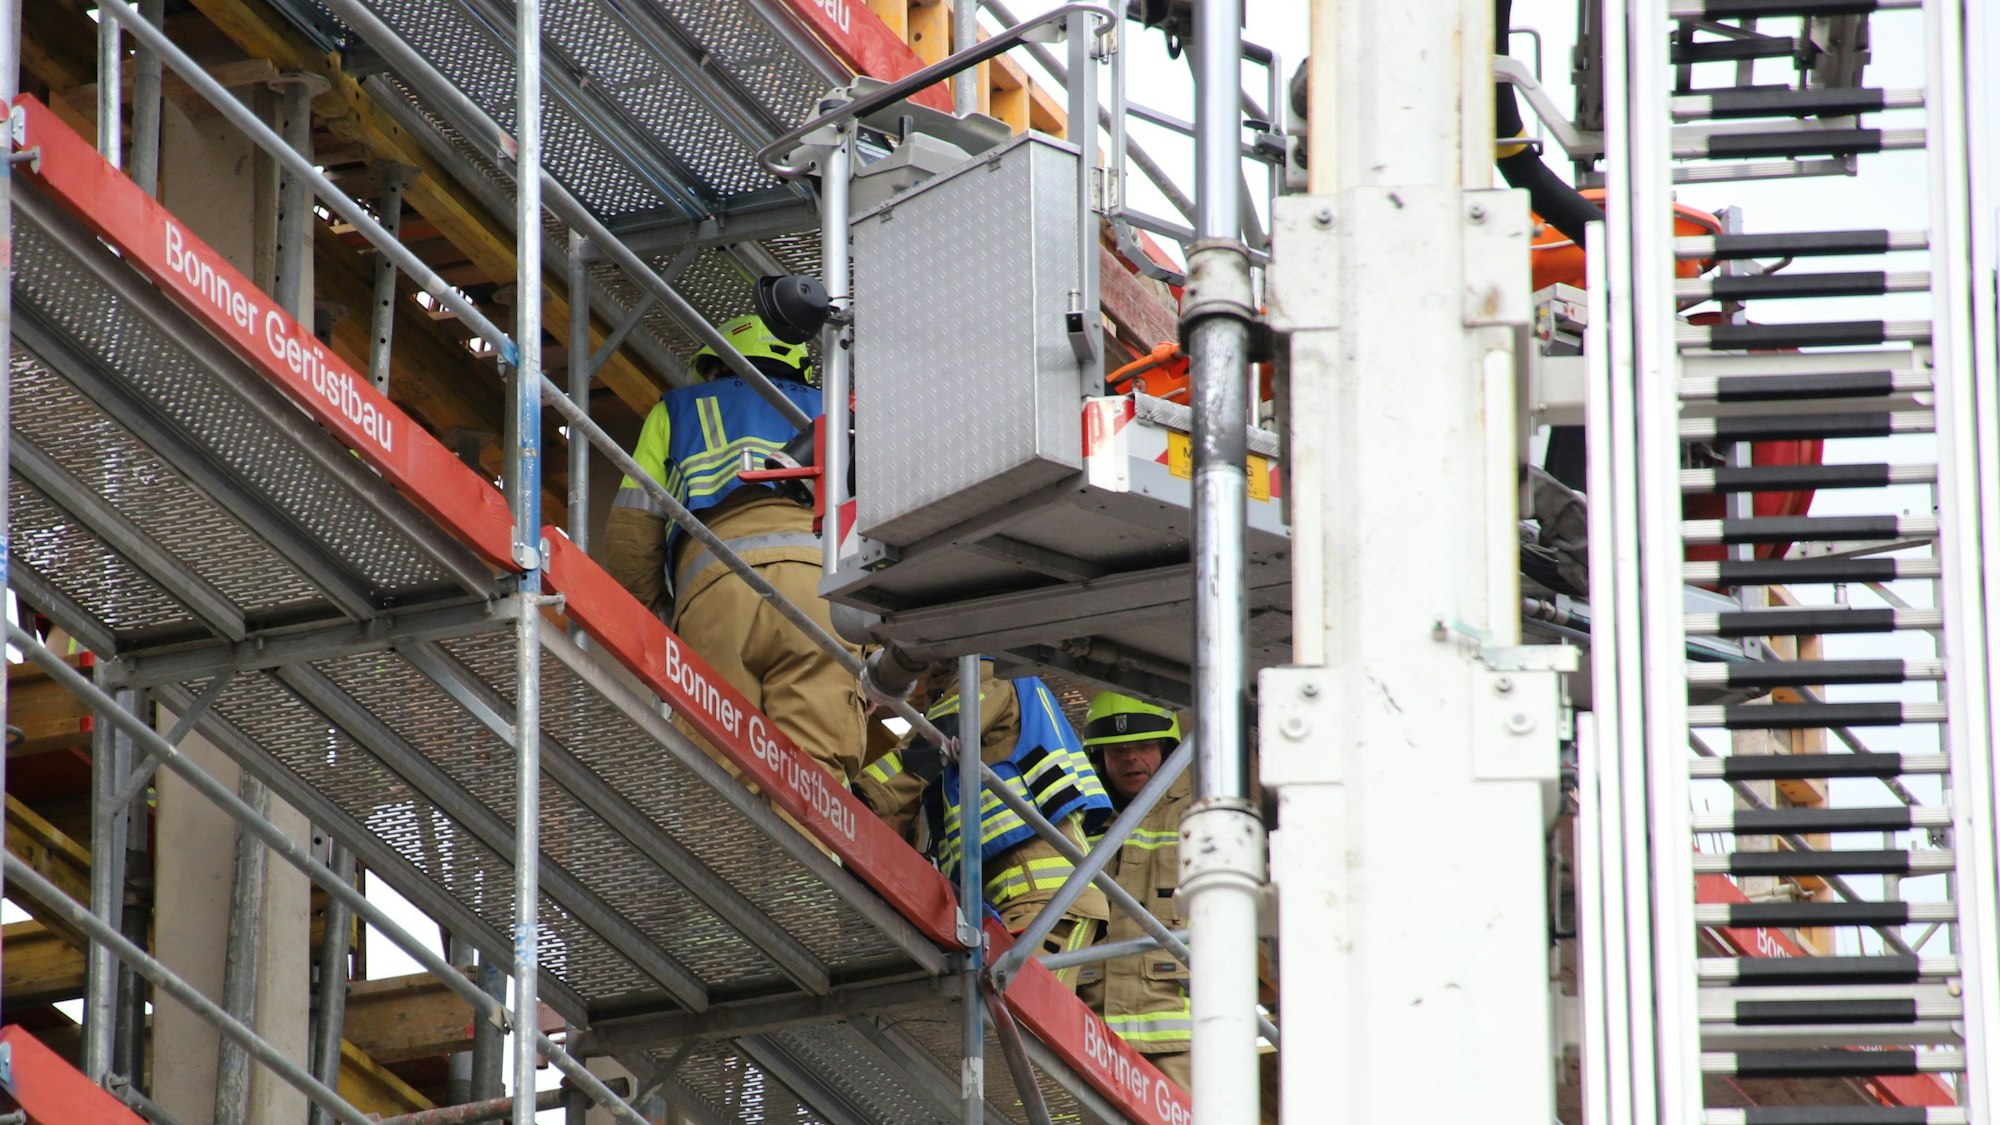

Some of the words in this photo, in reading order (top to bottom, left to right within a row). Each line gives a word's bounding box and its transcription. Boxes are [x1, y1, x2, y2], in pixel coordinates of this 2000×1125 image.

[165, 220, 258, 335] Bonner
[265, 310, 392, 452] Gerüstbau
[665, 636, 743, 738] Bonner
[749, 715, 855, 841] Gerüstbau
[1084, 1013, 1150, 1104] Bonner
